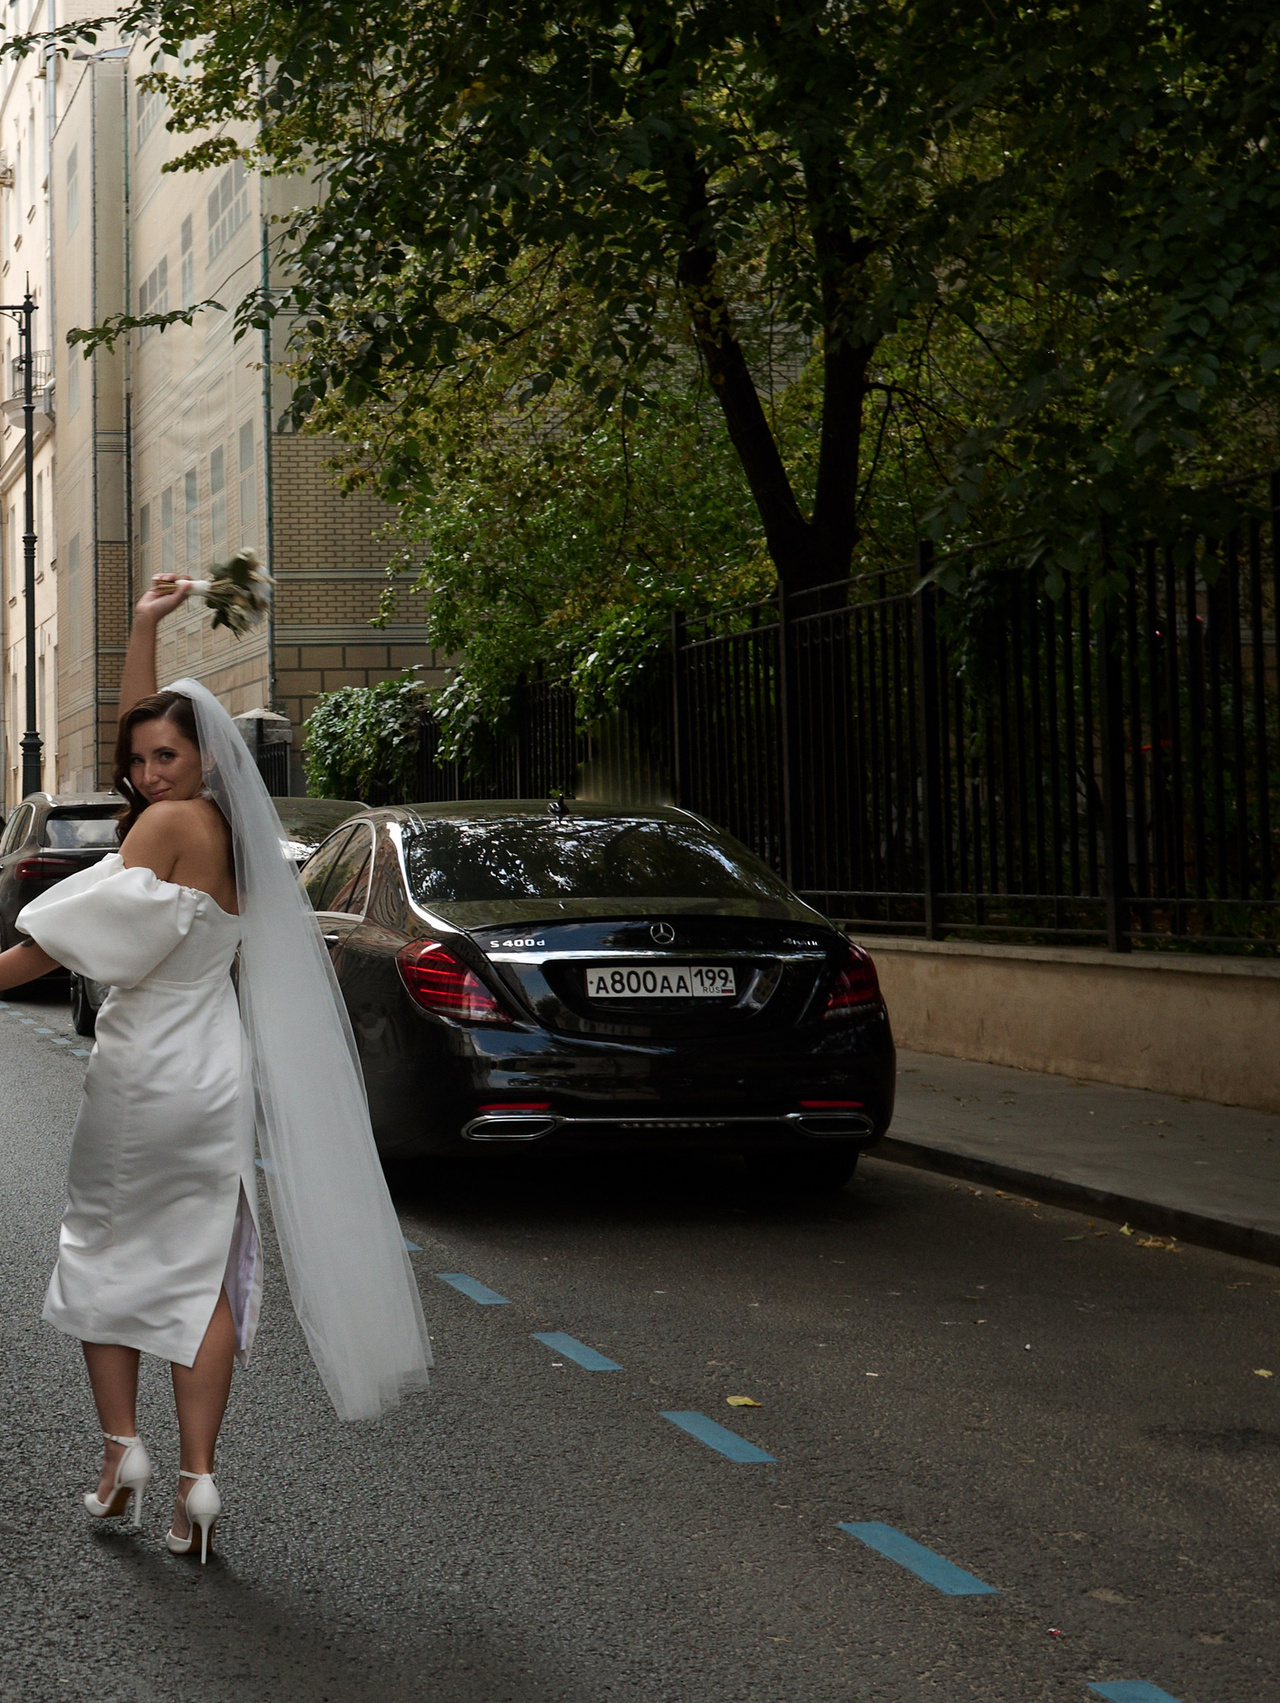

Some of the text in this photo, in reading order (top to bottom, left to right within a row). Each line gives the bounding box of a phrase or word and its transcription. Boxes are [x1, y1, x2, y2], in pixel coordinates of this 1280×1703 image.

[489, 939, 545, 948] S 400d
[595, 969, 729, 994] А800АА 199
[702, 986, 721, 994] RUS
